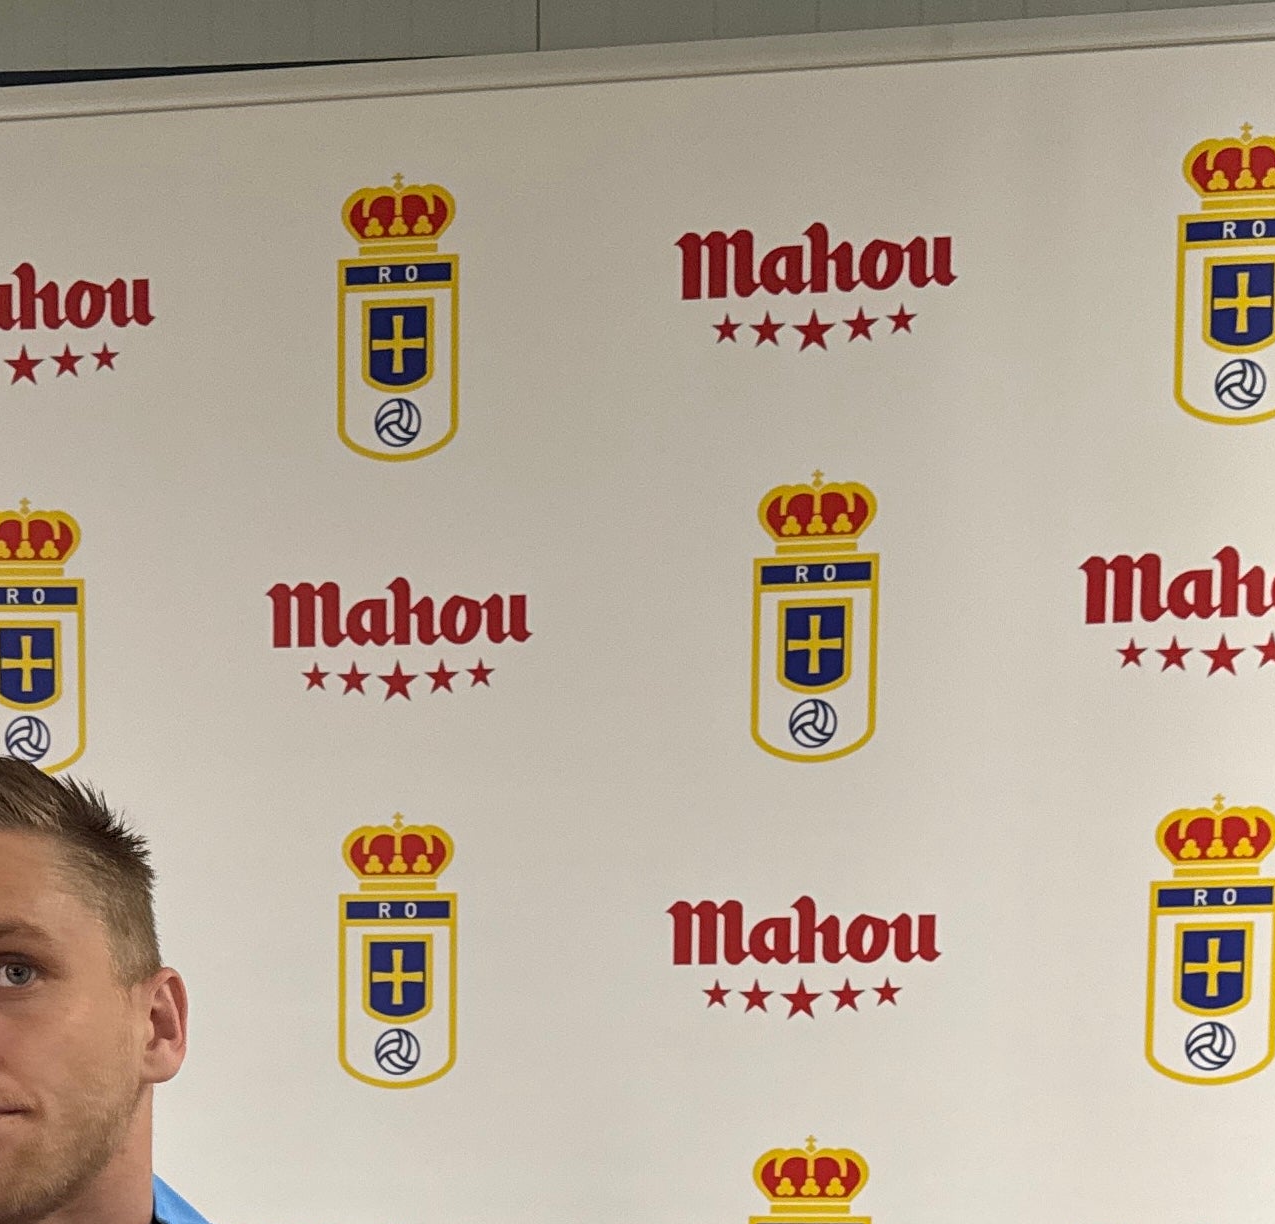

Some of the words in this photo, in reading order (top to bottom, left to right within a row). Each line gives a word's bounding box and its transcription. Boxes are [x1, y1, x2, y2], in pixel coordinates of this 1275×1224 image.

[674, 222, 957, 300] Mahou
[266, 577, 532, 648] Mahou
[666, 896, 941, 965] Mahou
